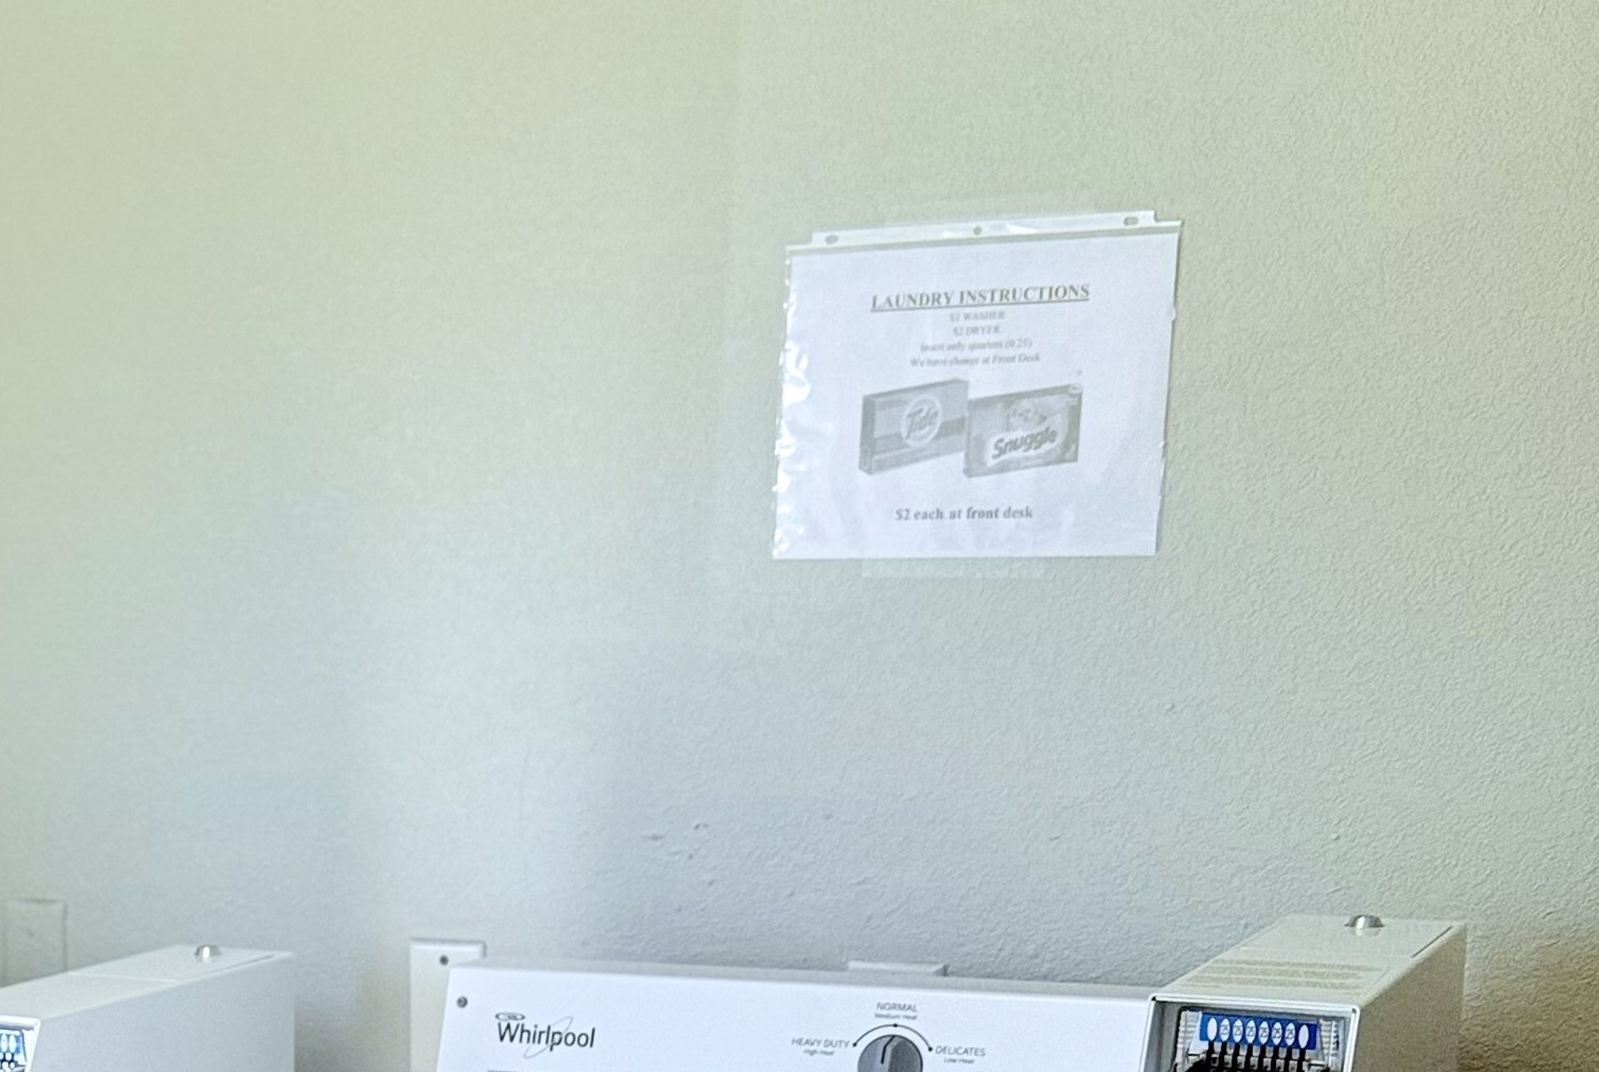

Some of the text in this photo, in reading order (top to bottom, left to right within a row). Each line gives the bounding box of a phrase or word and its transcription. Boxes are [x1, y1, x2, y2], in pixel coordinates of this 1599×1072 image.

[871, 284, 1090, 310] LAUNDRY INSTRUCTIONS
[905, 405, 939, 440] Tide
[992, 426, 1057, 460] Snuggle
[914, 508, 944, 520] each
[949, 509, 962, 520] at
[965, 507, 1000, 520] front
[1003, 506, 1033, 519] desk
[876, 1002, 918, 1012] NORMAL
[497, 1021, 596, 1052] Whirlpool
[791, 1037, 850, 1048] HEAVY DUTY
[935, 1045, 986, 1057] DELICATES
